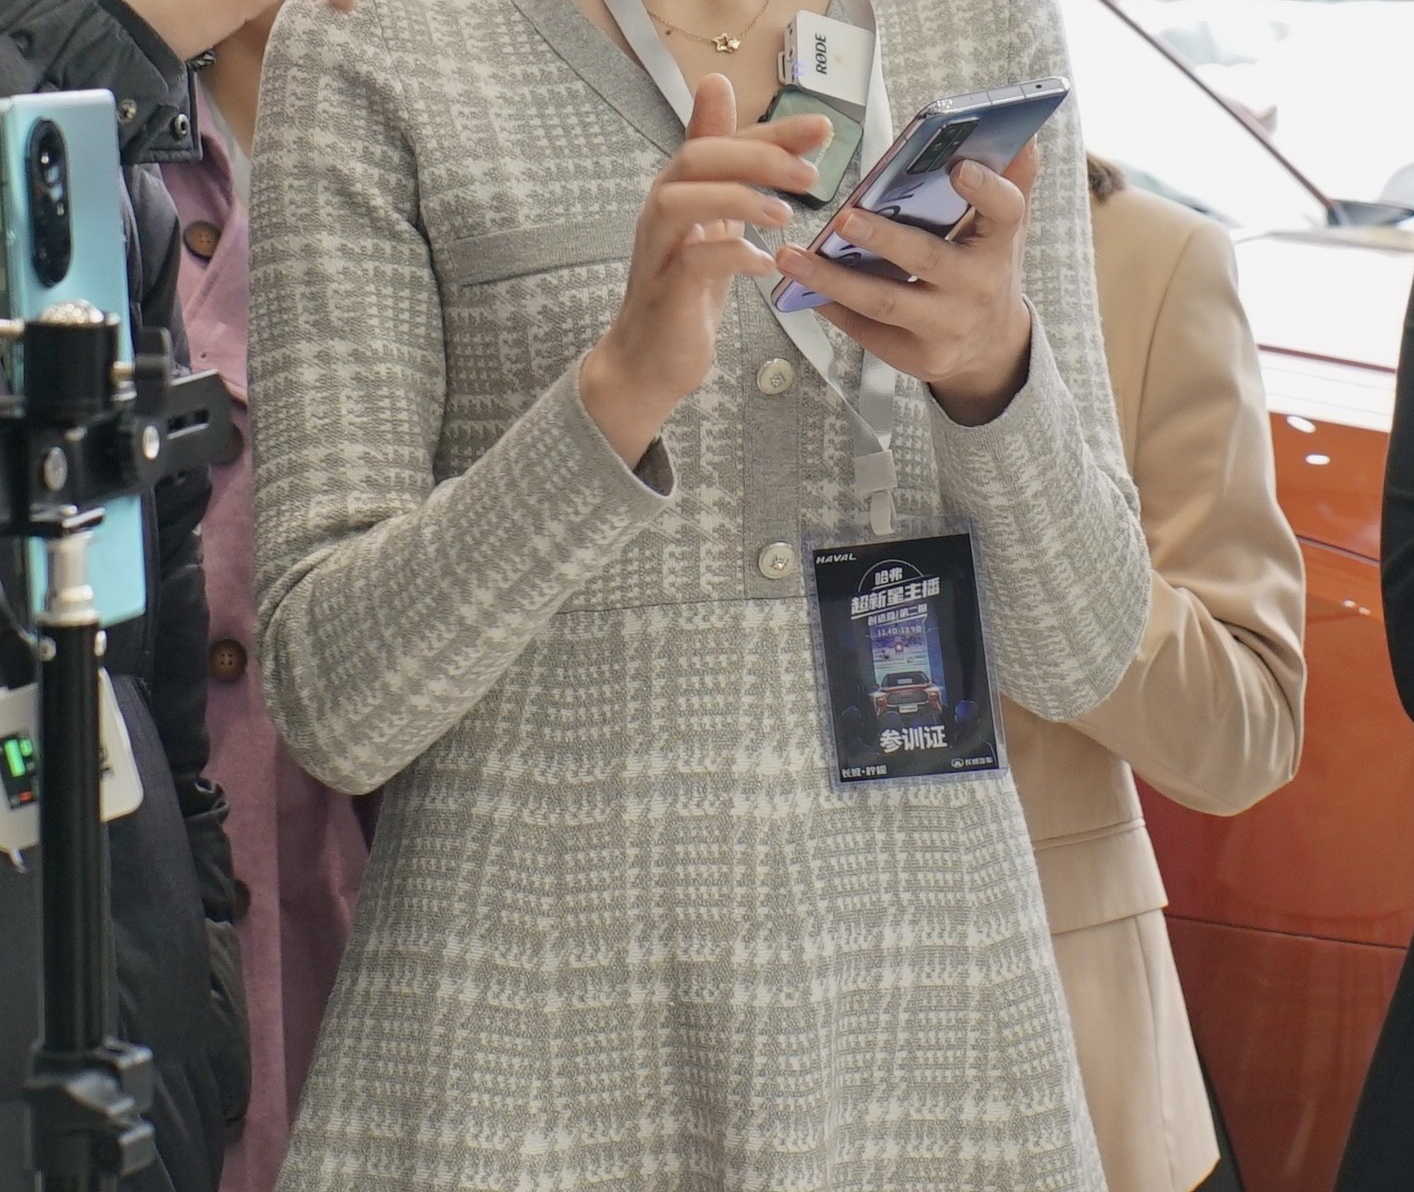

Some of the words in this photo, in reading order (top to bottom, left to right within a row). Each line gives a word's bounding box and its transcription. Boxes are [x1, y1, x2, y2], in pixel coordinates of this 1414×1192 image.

[815, 553, 857, 565] HAVAL
[874, 567, 904, 586] 哈弗
[850, 577, 941, 615] 超新星主播
[879, 725, 948, 753] 参训证
